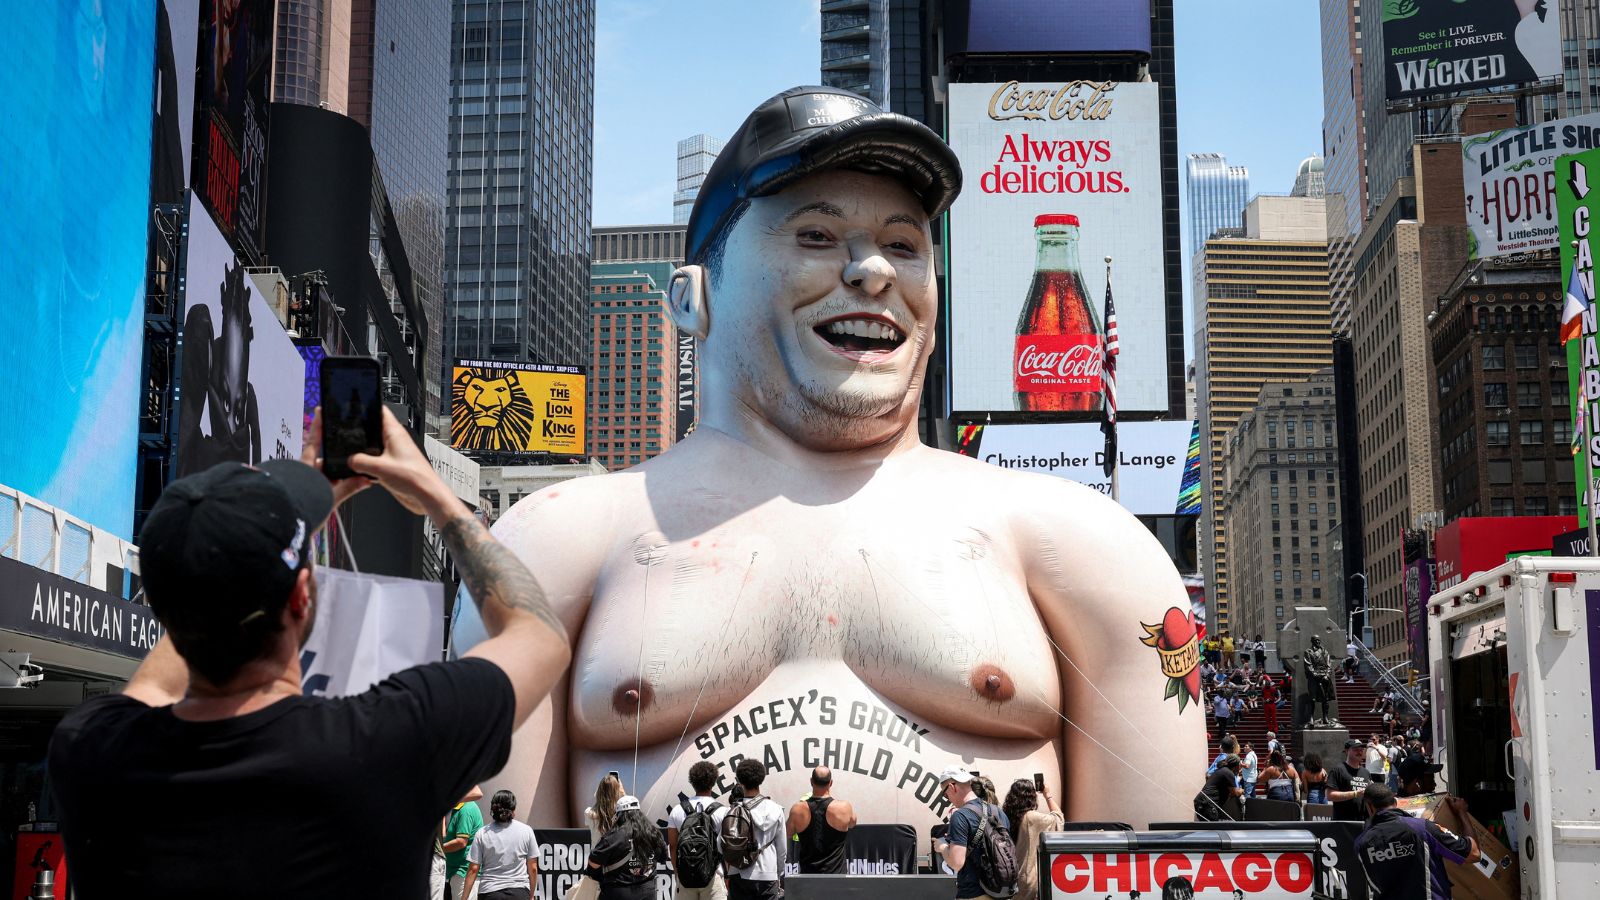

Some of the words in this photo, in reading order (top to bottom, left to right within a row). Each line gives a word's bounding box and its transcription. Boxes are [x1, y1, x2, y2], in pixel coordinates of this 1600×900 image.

[1391, 41, 1443, 56] Remember
[1444, 39, 1453, 49] it
[1454, 32, 1507, 47] FOREVER.
[1418, 31, 1436, 41] See
[1439, 29, 1446, 38] it
[1449, 24, 1477, 36] LIVE.
[997, 133, 1112, 169] Always
[1480, 126, 1557, 176] LITTLE
[1538, 155, 1554, 166] OF
[980, 164, 1131, 194] delicious.
[1497, 241, 1528, 252] Westside
[1528, 237, 1554, 247] Theatre
[550, 388, 570, 401] THE
[546, 401, 573, 418] LION
[542, 419, 576, 438] KING
[985, 451, 1089, 471] Christopher
[1094, 450, 1177, 470] DLange
[31, 582, 123, 643] AMERICAN
[694, 688, 837, 759] SPACEX'S
[848, 700, 930, 753] GROK
[762, 739, 792, 776] AI
[803, 737, 893, 781] CHILD
[897, 760, 952, 824] POR
[1367, 841, 1416, 864] FedEx
[1051, 852, 1314, 893] CHICAGO
